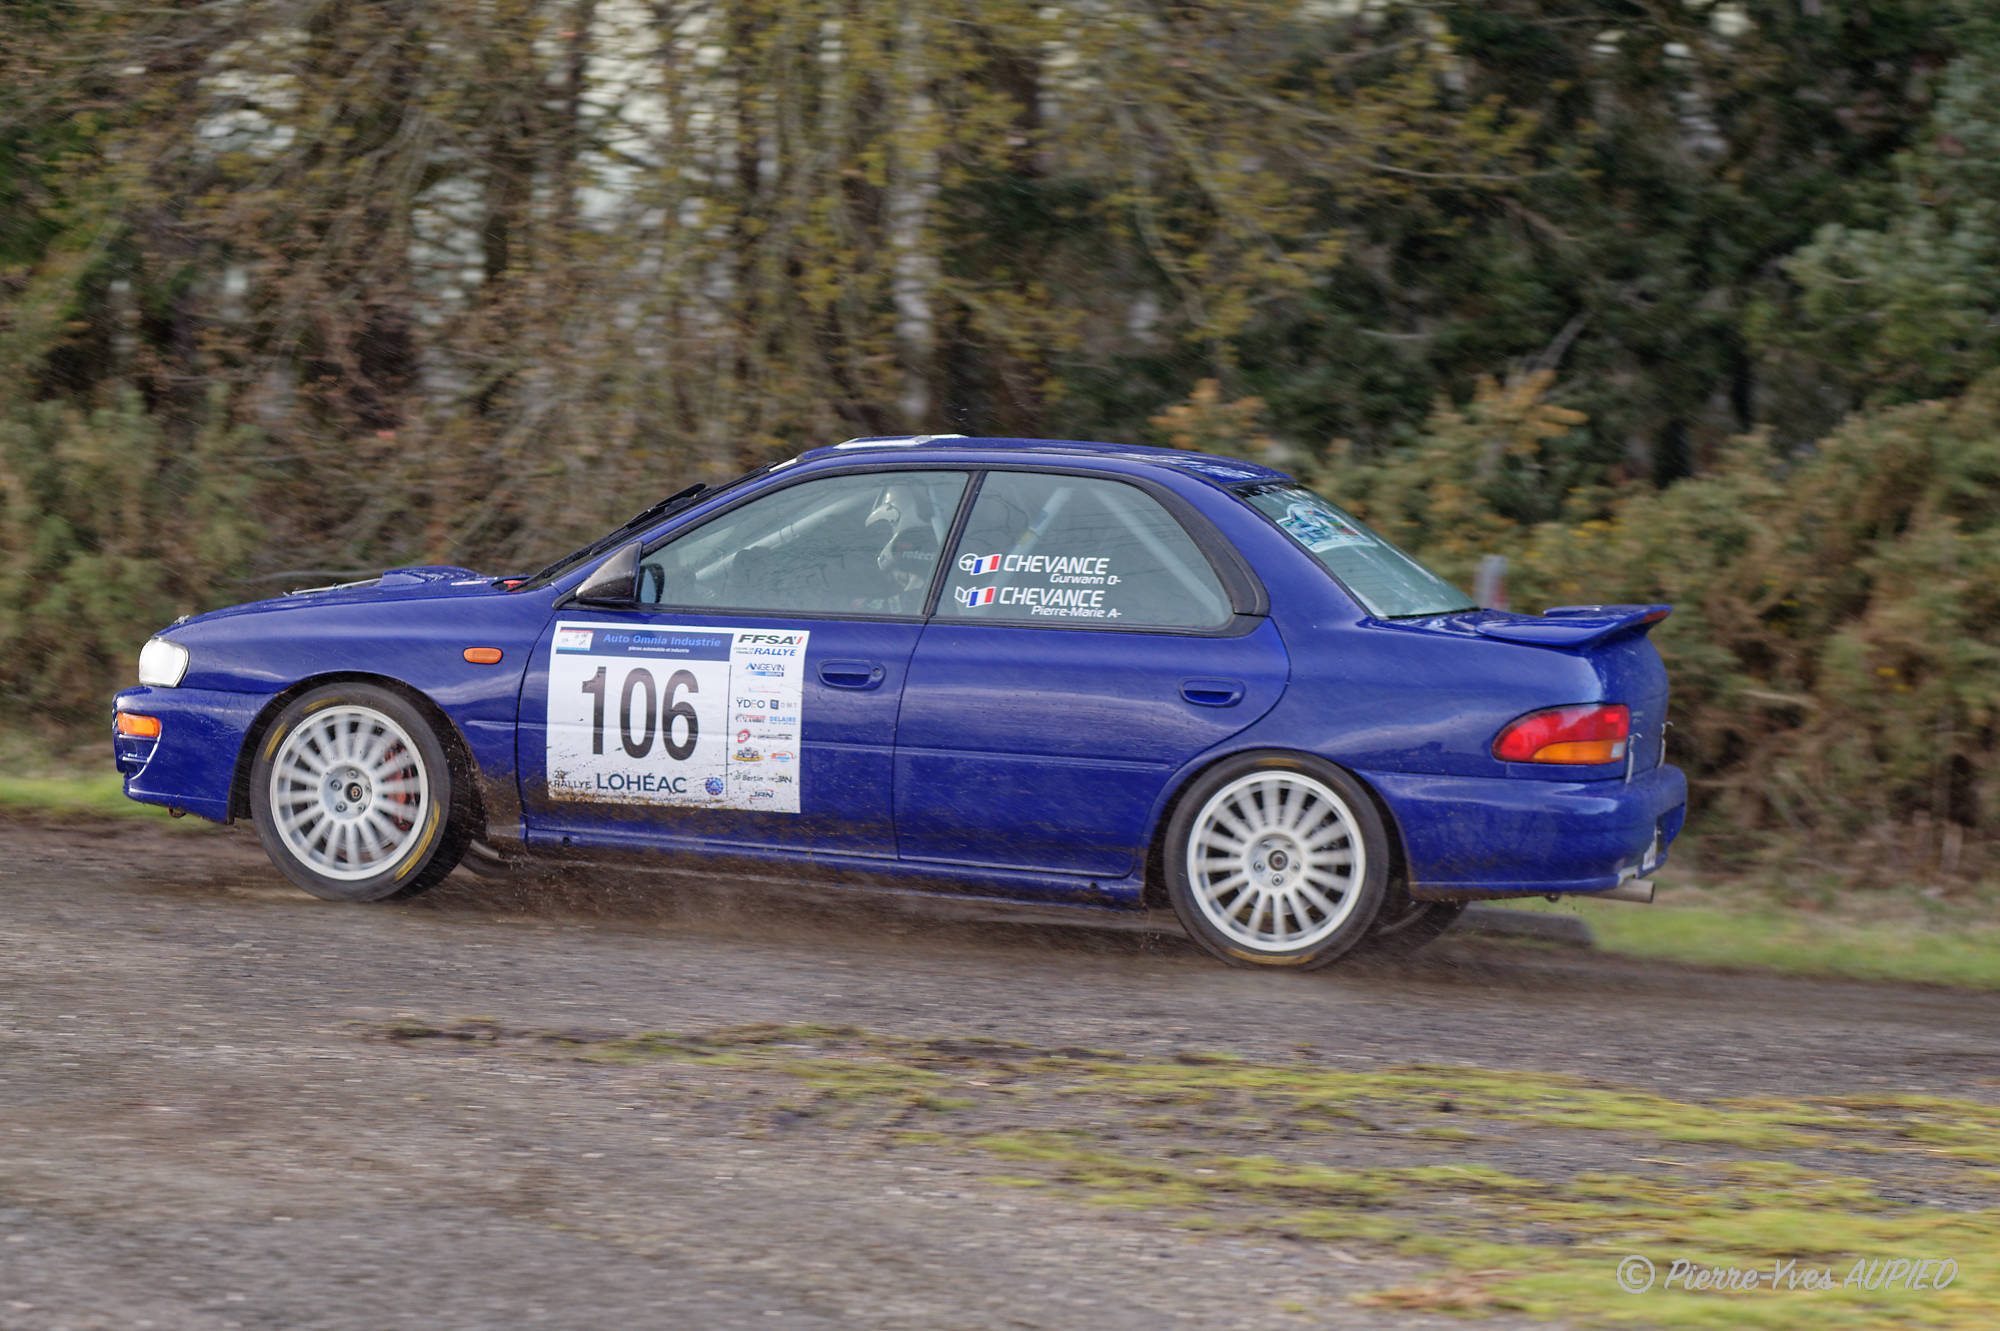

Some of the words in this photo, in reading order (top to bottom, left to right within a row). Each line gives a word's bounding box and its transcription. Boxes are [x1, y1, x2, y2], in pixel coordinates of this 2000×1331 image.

[1003, 554, 1110, 575] CHEVANCE
[1049, 573, 1104, 584] Gurwann
[999, 586, 1105, 607] CHEVANCE
[1031, 605, 1105, 618] Pierre-Marie
[603, 634, 630, 644] Auto
[633, 635, 667, 645] Omnia
[670, 635, 721, 647] Industrie
[738, 634, 794, 645] FFSA
[754, 647, 798, 656] RALLYE
[581, 666, 699, 761] 106
[554, 780, 592, 789] RALLYE
[597, 772, 687, 793] LOHÉAC
